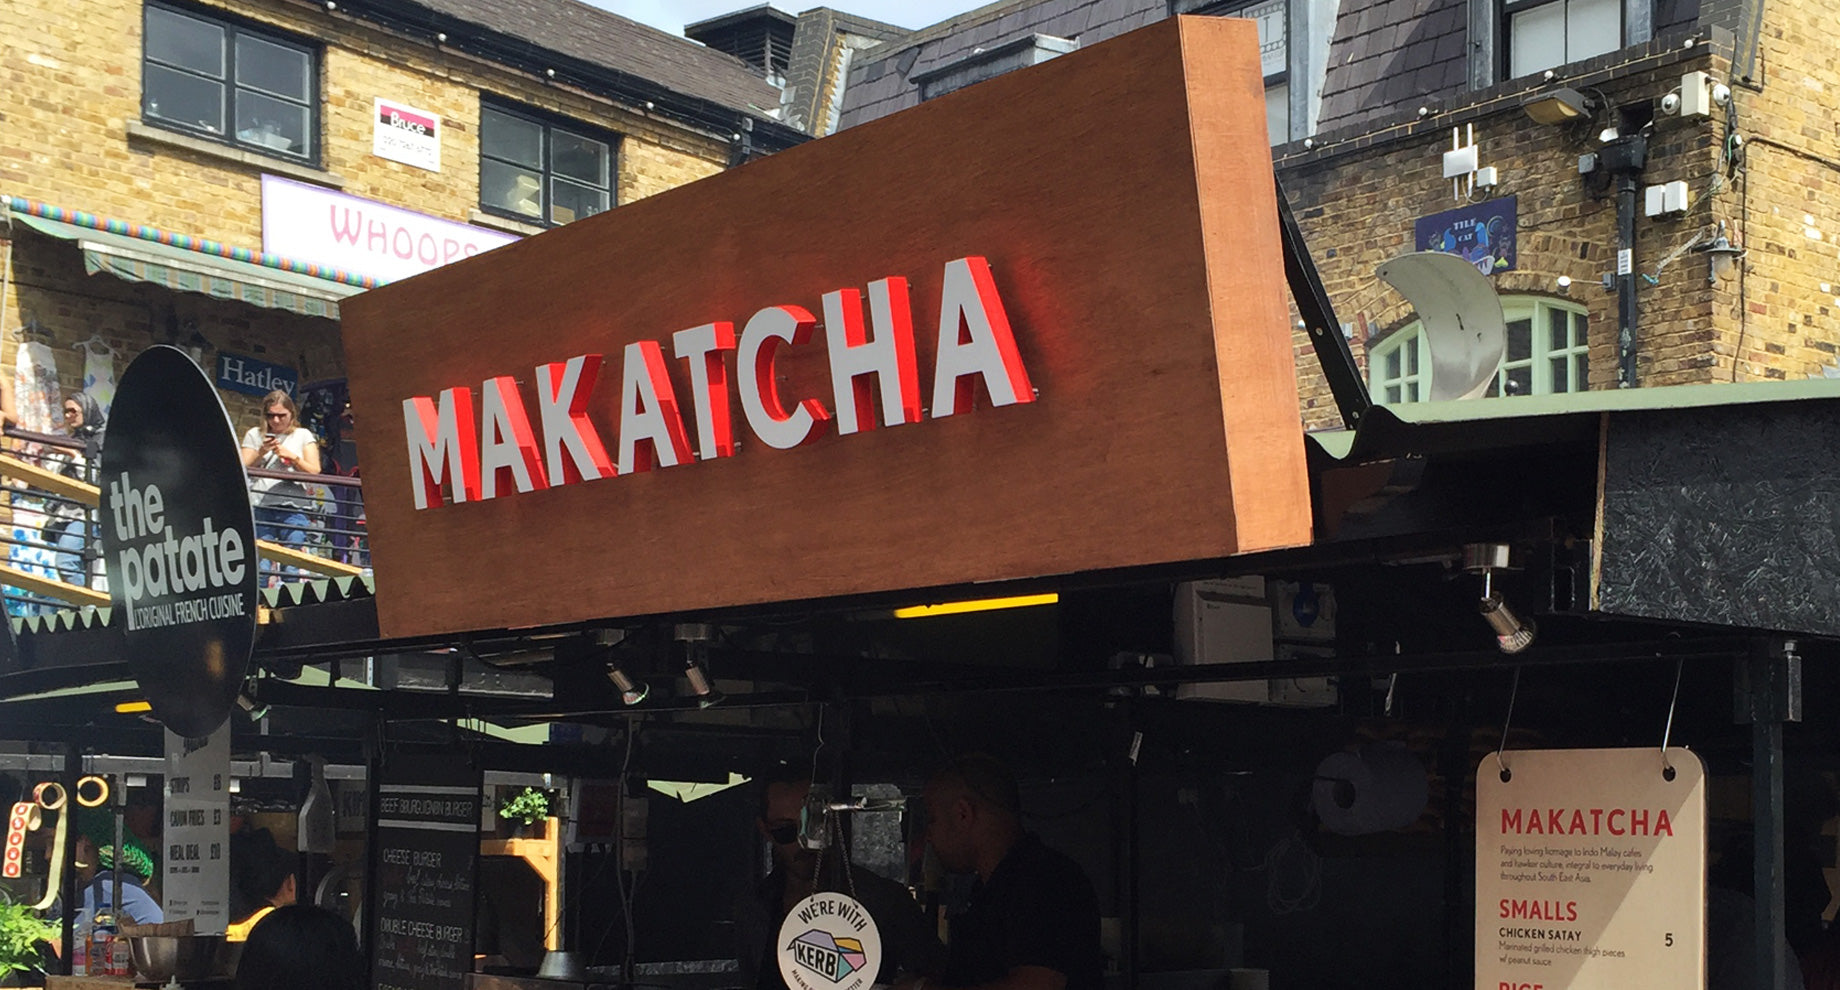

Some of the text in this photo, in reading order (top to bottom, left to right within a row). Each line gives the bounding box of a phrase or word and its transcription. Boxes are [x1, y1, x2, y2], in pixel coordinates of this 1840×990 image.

[390, 111, 426, 135] Bruce
[1453, 218, 1476, 231] TILE
[221, 356, 295, 396] Hatley
[403, 256, 1037, 510] MAKATCHA
[109, 471, 165, 542] the
[119, 516, 246, 631] patate
[175, 598, 209, 625] FRENCH
[209, 593, 245, 620] CUISINE
[1501, 808, 1674, 837] MAKATCHA
[1600, 847, 1622, 859] Malay
[1500, 860, 1513, 868] and
[1601, 861, 1633, 872] everyday
[1634, 861, 1654, 874] living
[1538, 871, 1557, 882] South
[1559, 872, 1574, 882] East
[798, 900, 868, 932] WE'RE WITH
[1499, 898, 1578, 922] SMALLS
[1499, 927, 1674, 947] CHICKEN SATAY 5
[1499, 940, 1533, 952] Marinated
[1556, 945, 1582, 955] chicken
[1602, 949, 1625, 958] pieces
[796, 943, 837, 977] KERB
